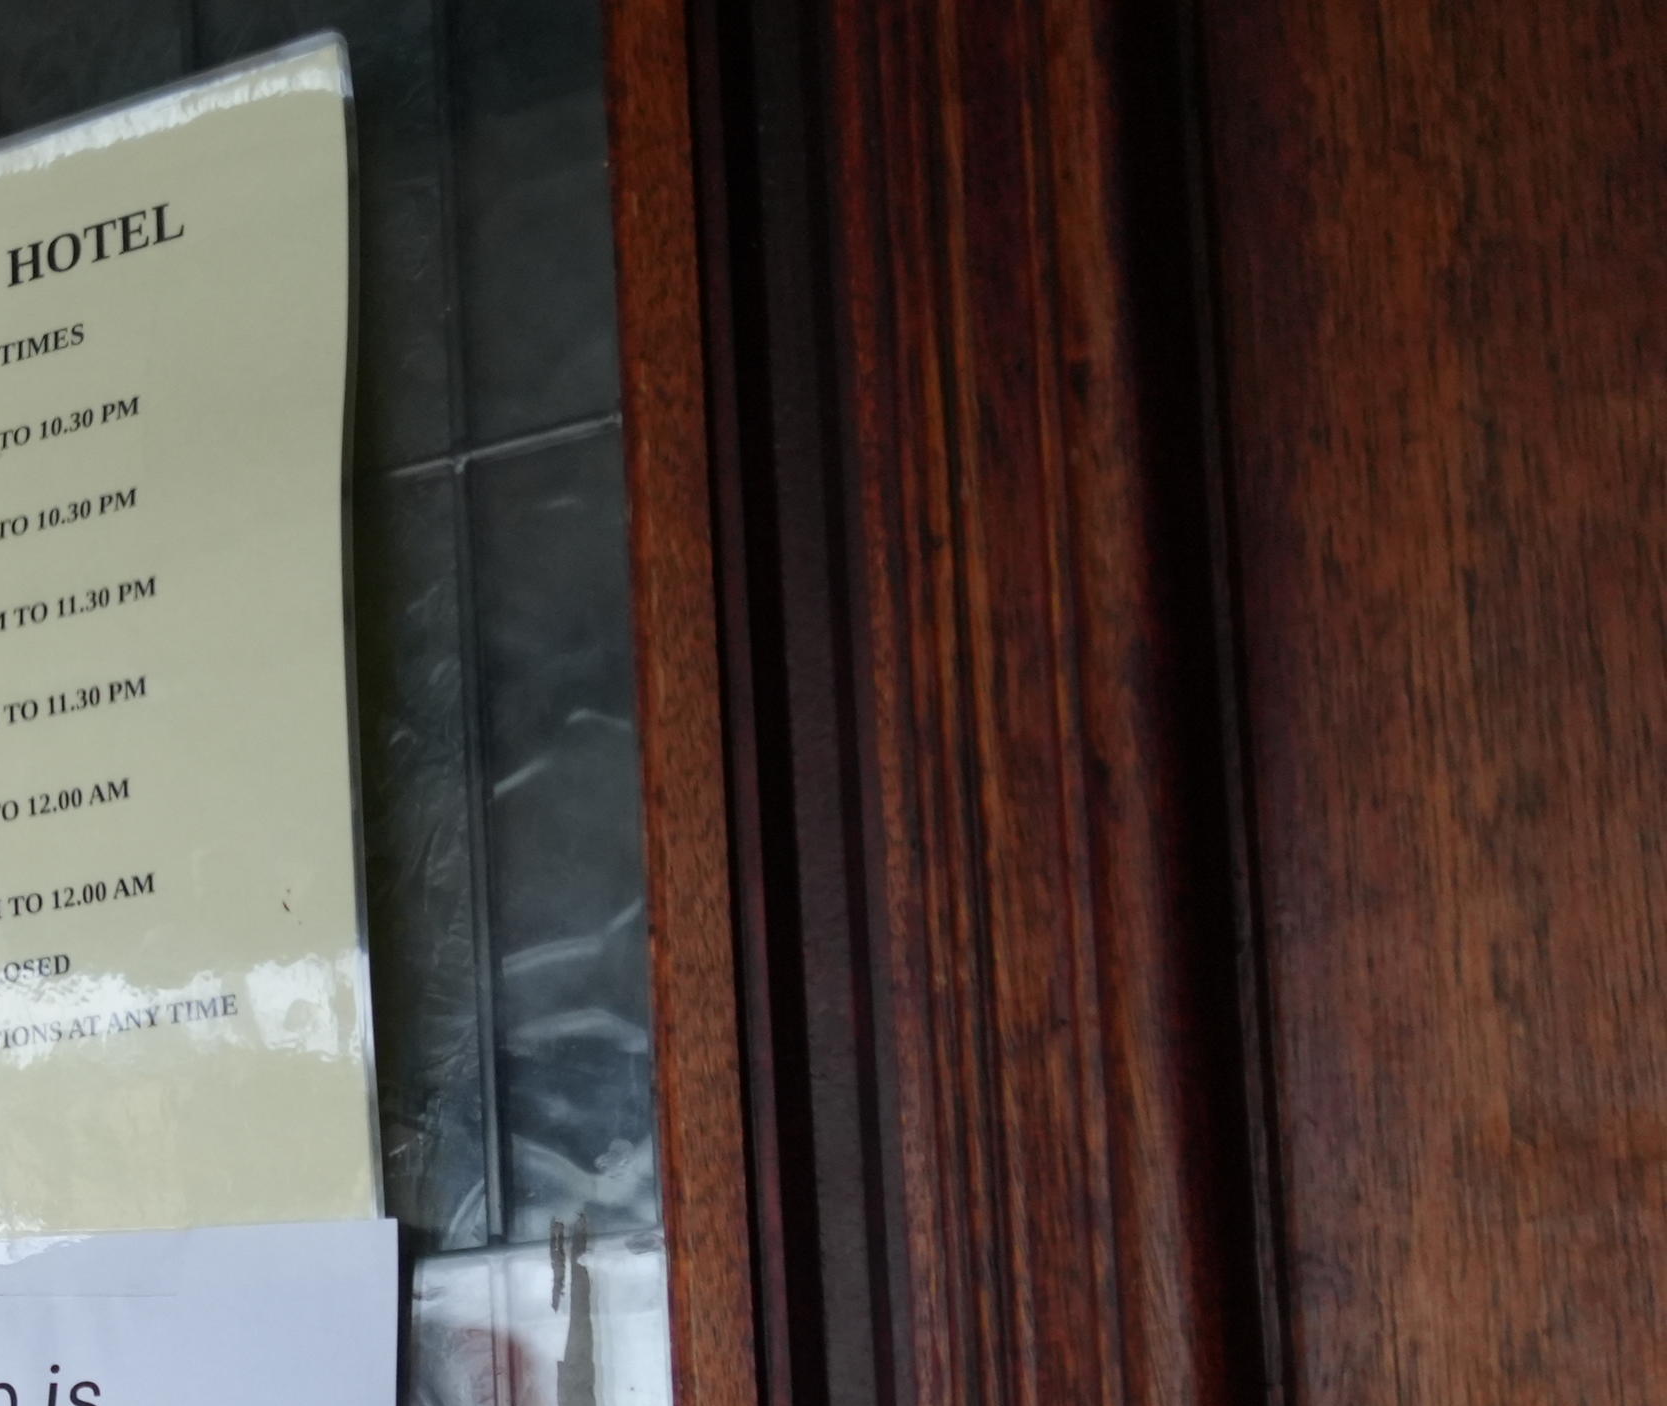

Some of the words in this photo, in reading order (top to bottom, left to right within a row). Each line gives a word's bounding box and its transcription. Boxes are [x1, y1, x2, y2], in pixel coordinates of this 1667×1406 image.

[7, 201, 185, 288] HOTEL
[39, 407, 94, 440] 10.30
[101, 396, 141, 424] PM
[36, 498, 91, 531] 10.30
[98, 487, 138, 514] PM
[14, 601, 49, 627] TO
[56, 586, 110, 618] 11.30
[118, 575, 157, 602] PM
[3, 698, 39, 725] TO
[47, 684, 101, 717] 11.30
[108, 675, 147, 702] PM
[28, 786, 82, 818] 12.00
[89, 777, 130, 805] AM
[8, 892, 43, 918] TO
[51, 880, 107, 911] 12.00
[113, 872, 155, 899] AM
[66, 1014, 102, 1042] AT
[108, 1006, 160, 1035] ANY
[166, 993, 239, 1024] TIME
